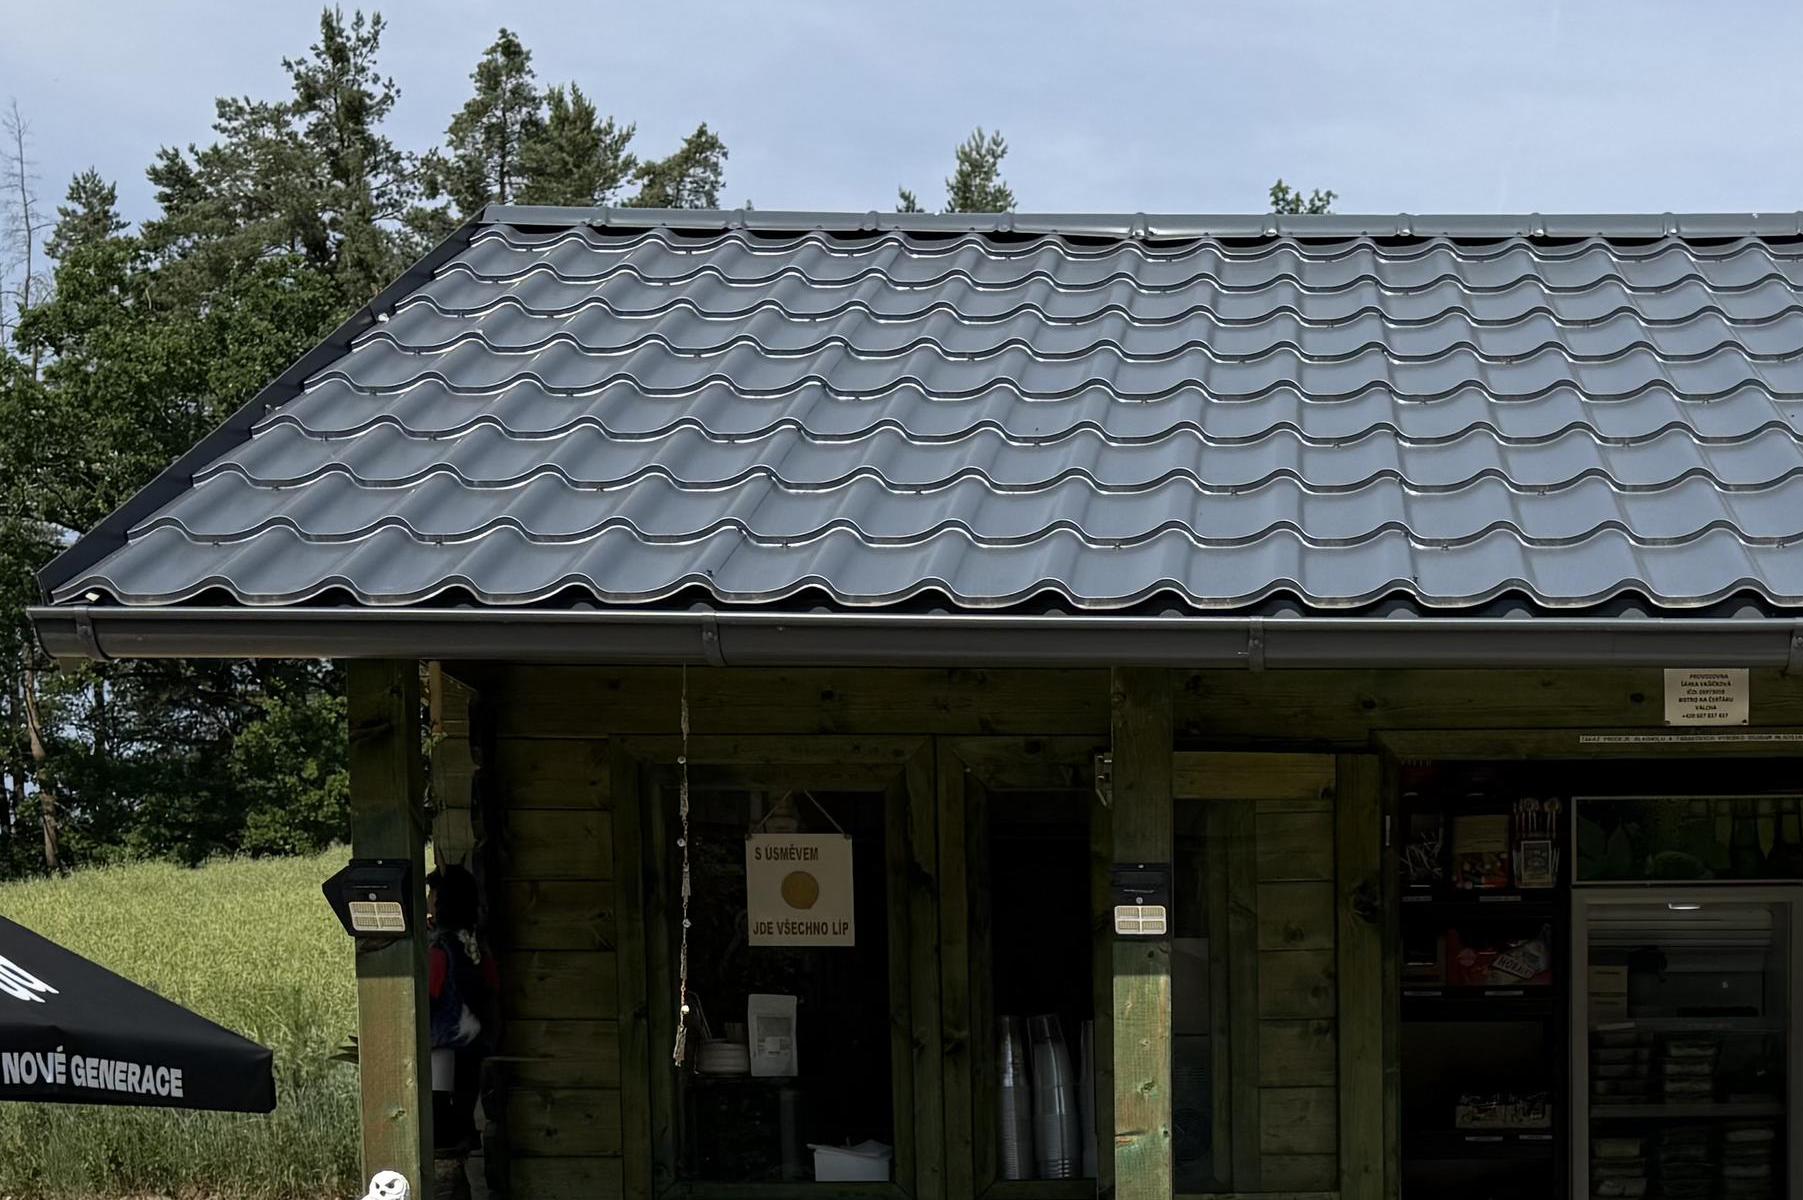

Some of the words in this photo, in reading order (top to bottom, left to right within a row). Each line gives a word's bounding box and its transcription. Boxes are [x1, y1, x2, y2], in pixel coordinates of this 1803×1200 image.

[754, 846, 763, 862] S
[764, 843, 820, 862] ÚSMĚVEM
[752, 921, 775, 937] JDE
[776, 918, 830, 937] VŠECHNO
[831, 918, 850, 938] LÍP
[2, 1045, 67, 1085] NOVÉ
[71, 1055, 184, 1098] GENERACE
